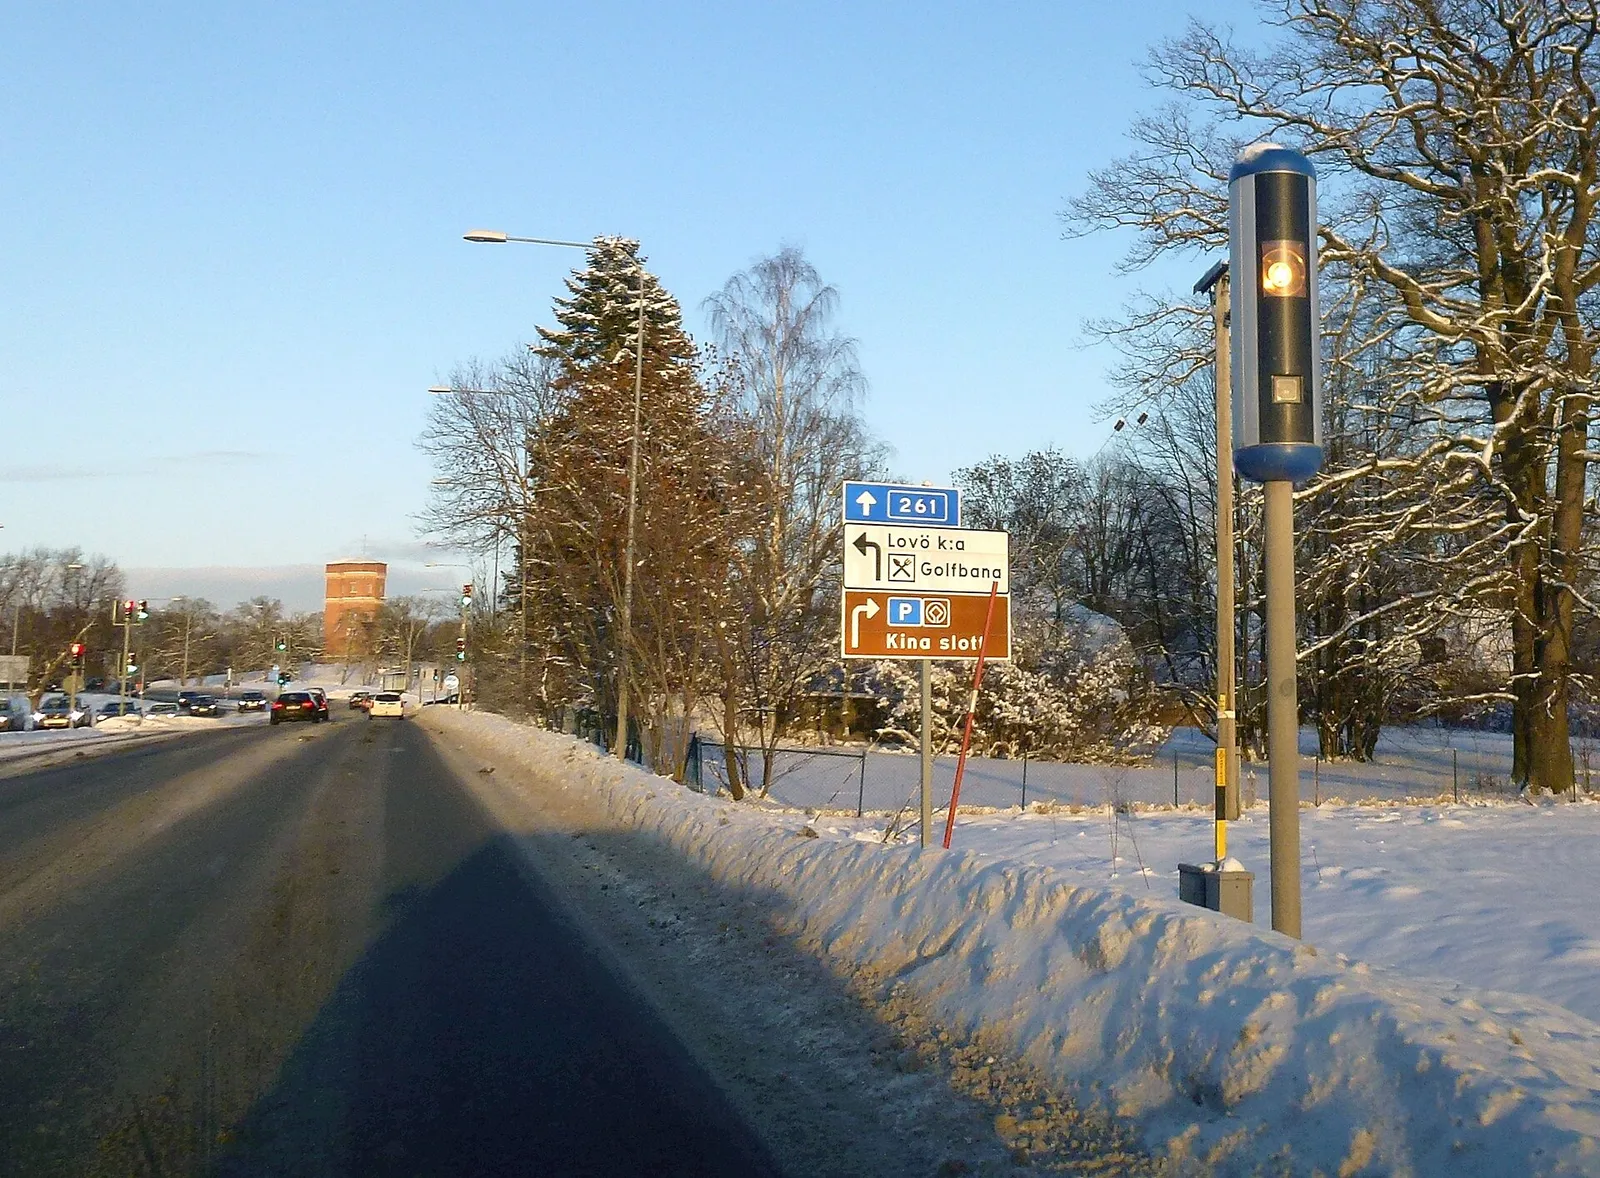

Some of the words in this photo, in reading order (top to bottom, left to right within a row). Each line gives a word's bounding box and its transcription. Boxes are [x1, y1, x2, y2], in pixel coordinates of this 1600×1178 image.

[899, 497, 936, 515] 261
[888, 533, 930, 549] Lovö
[938, 536, 965, 551] k:a
[920, 562, 1002, 579] Golfbana
[898, 602, 913, 621] P
[885, 632, 931, 650] Kina
